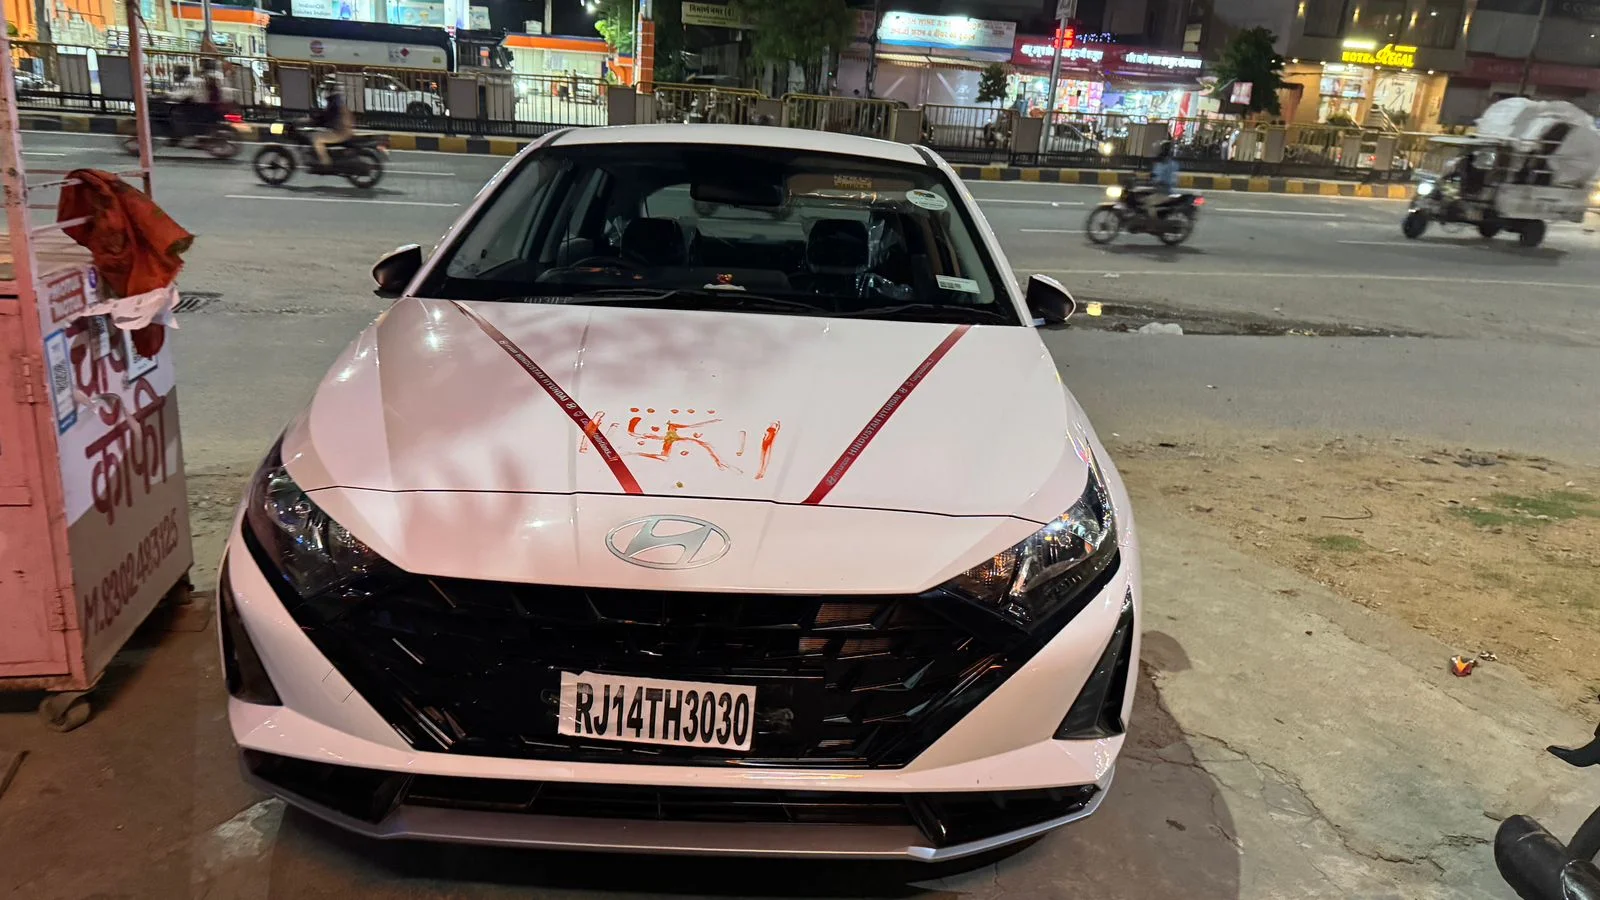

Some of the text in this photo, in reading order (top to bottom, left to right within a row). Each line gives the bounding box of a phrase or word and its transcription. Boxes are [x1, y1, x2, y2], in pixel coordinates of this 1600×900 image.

[543, 375, 569, 403] HYUNDAI
[848, 418, 881, 456] HINDUSTAN
[878, 393, 902, 419] HYUNDAI
[574, 682, 750, 746] RJ14TH3030
